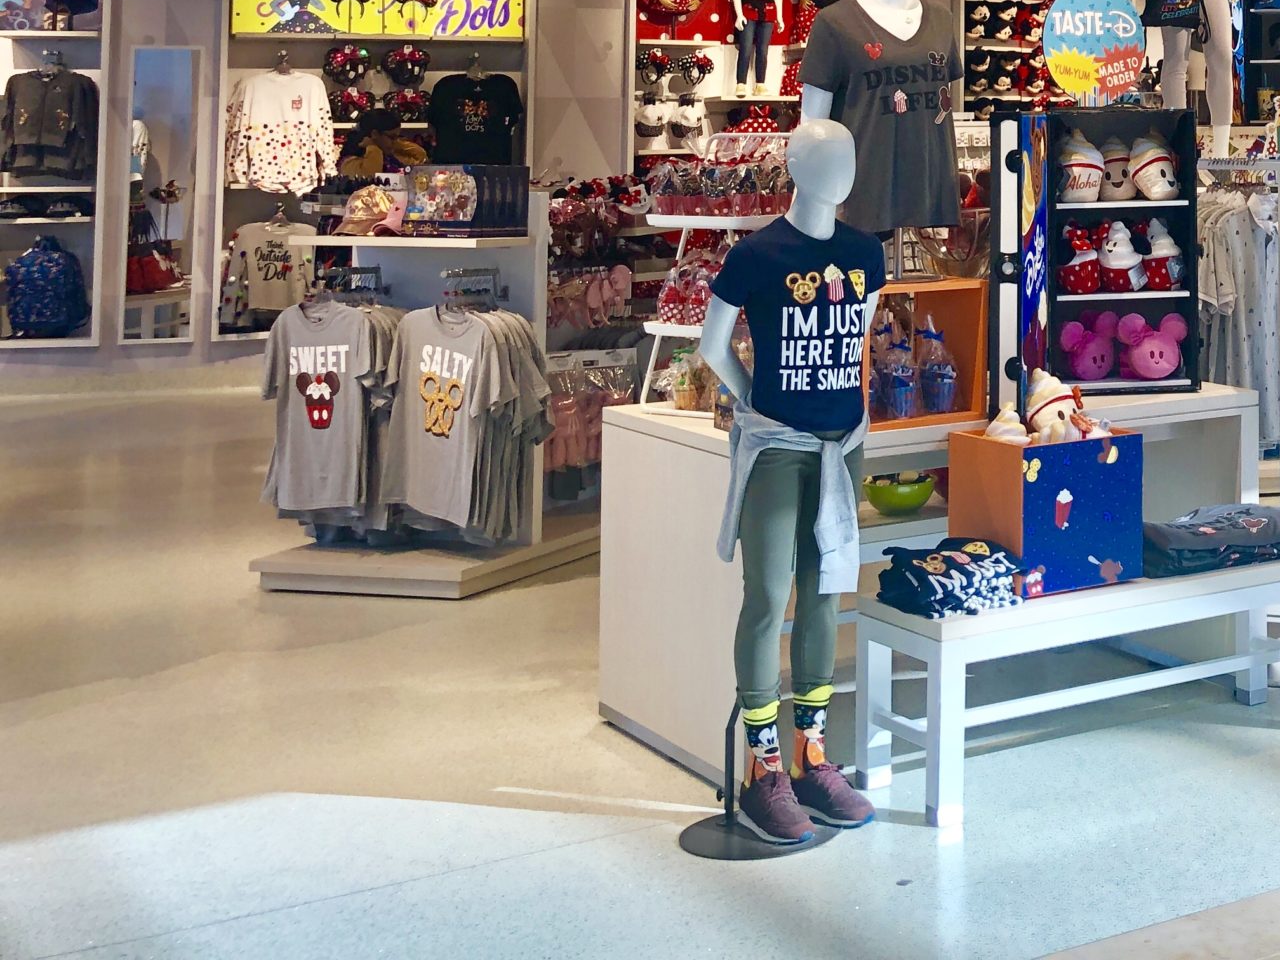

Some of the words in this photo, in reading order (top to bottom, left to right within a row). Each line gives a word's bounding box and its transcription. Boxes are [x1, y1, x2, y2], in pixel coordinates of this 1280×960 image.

[863, 62, 947, 91] DISNE
[1053, 63, 1091, 81] YUM-YUM
[1098, 61, 1126, 78] MADE
[1126, 56, 1139, 69] TO
[1106, 70, 1136, 88] ORDER
[880, 90, 939, 116] LFE
[254, 246, 292, 264] Outside
[265, 239, 284, 250] Think
[781, 305, 818, 337] I'M
[824, 303, 866, 336] JUST
[289, 344, 350, 376] SWEET
[780, 338, 835, 366] HERE
[840, 336, 865, 365] FOR
[419, 344, 473, 385] SALTY
[779, 368, 812, 391] THE
[816, 365, 861, 391] SNACKS
[963, 551, 1017, 587] JUST
